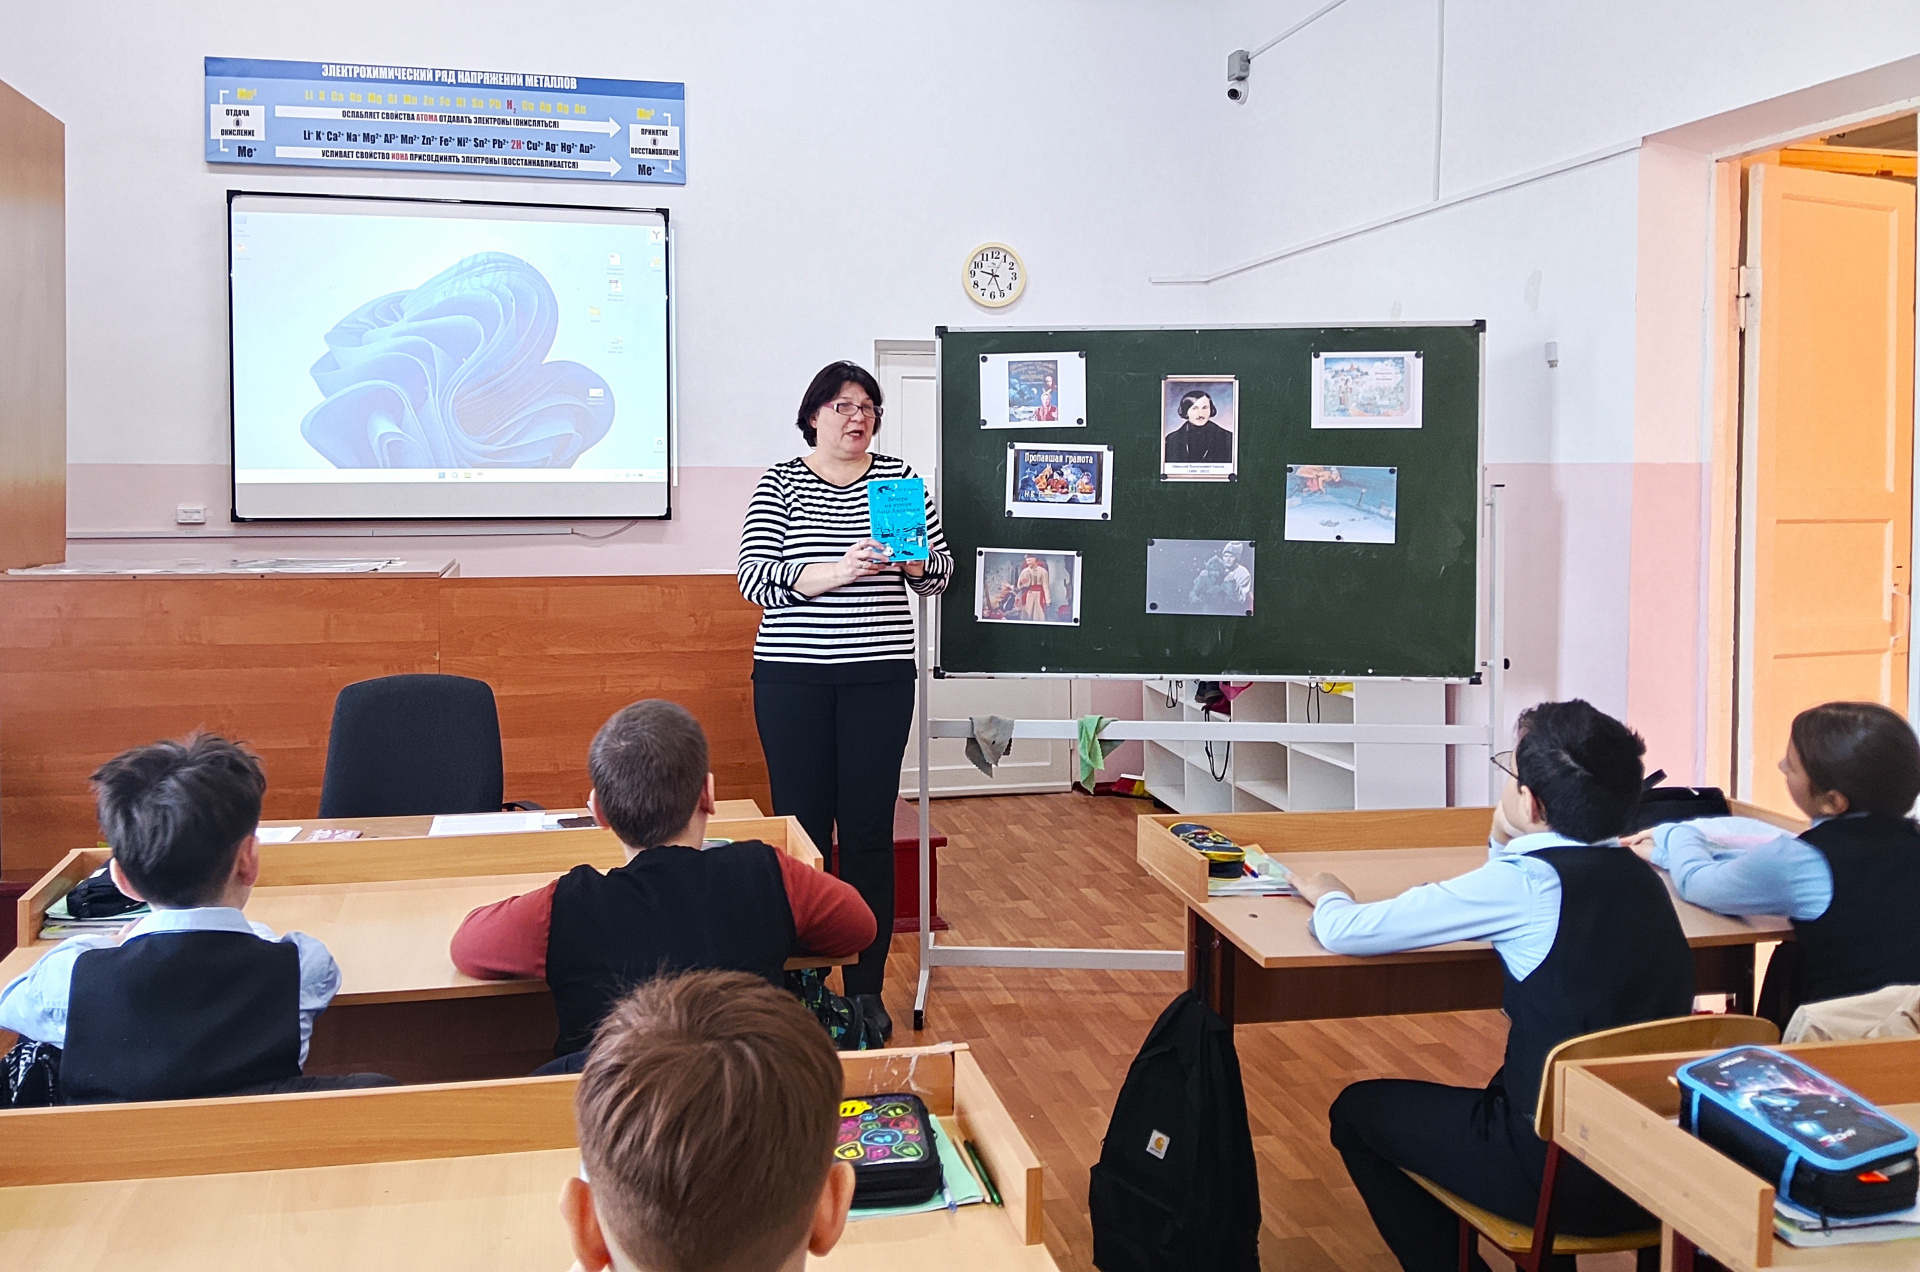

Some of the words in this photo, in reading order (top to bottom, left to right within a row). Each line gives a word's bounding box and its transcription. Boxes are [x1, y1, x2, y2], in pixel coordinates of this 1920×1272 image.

[321, 64, 433, 82] ЭЛЕКТРОХИМИЧЕСКИЙ
[434, 69, 456, 84] РЯД
[457, 71, 523, 86] НАПРЯЖЕНИЙ
[525, 74, 577, 90] МЕТАЛЛОВ
[225, 108, 250, 117] ОТДАЧА
[342, 110, 380, 120] ОСЛАБЛЯЕТ
[381, 111, 415, 121] СВОЙСТВА
[416, 113, 438, 122] АТОМА
[439, 114, 472, 124] ОТДАВАТЬ
[473, 116, 512, 126] ЭЛЕКТРОНЫ
[513, 118, 559, 129] (ОКИСЛЯТЬСЯ)
[220, 128, 255, 137] ОКИСЛЕНИЕ
[641, 128, 668, 137] ПРИНЯТИЕ
[630, 147, 679, 156] ВОССТАНОВЛЕНИЕ
[355, 150, 390, 160] СВОЙСТВО
[391, 152, 408, 160] ИОНА
[409, 153, 460, 163] ПРИСОЕДИНЯТЬ
[461, 155, 500, 165] ЭЛЕКТРОНЫ
[981, 253, 989, 261] 11
[991, 251, 1000, 259] 12
[1003, 254, 1007, 263] 1
[974, 261, 983, 269] 10
[1009, 262, 1014, 270] 2
[970, 270, 976, 278] 9
[1011, 272, 1017, 281] 3
[973, 280, 979, 289] 8
[1007, 282, 1012, 290] 4
[980, 288, 986, 297] 7
[989, 291, 996, 300] 6
[1000, 289, 1005, 298] 5
[1024, 452, 1063, 464] Пропавшая
[1065, 454, 1093, 465] грамота
